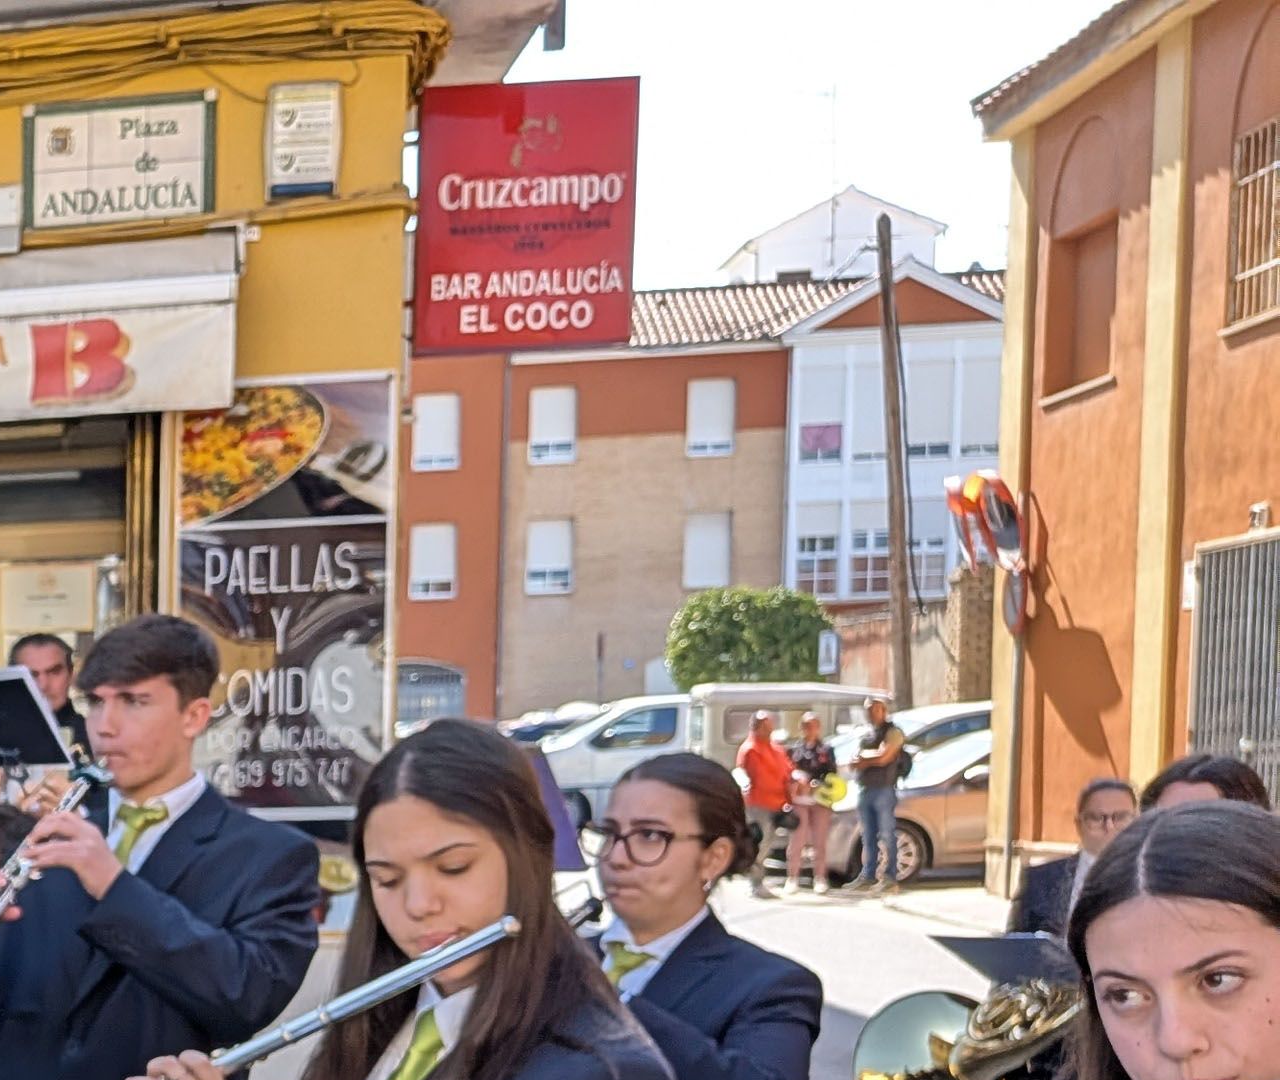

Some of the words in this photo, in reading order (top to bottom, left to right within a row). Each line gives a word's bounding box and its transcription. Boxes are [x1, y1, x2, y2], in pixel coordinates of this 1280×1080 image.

[120, 117, 178, 140] Plaza
[135, 152, 159, 173] de
[41, 176, 197, 219] ANDALUCÍA
[438, 172, 623, 212] Cruzcampo
[431, 272, 482, 301] BAR
[484, 259, 624, 298] ANDALUCÍA
[459, 305, 498, 334] EL
[504, 300, 594, 332] COCO
[29, 317, 136, 405] B
[203, 541, 360, 596] PAELLAS
[269, 606, 293, 655] Y
[206, 726, 254, 753] POR
